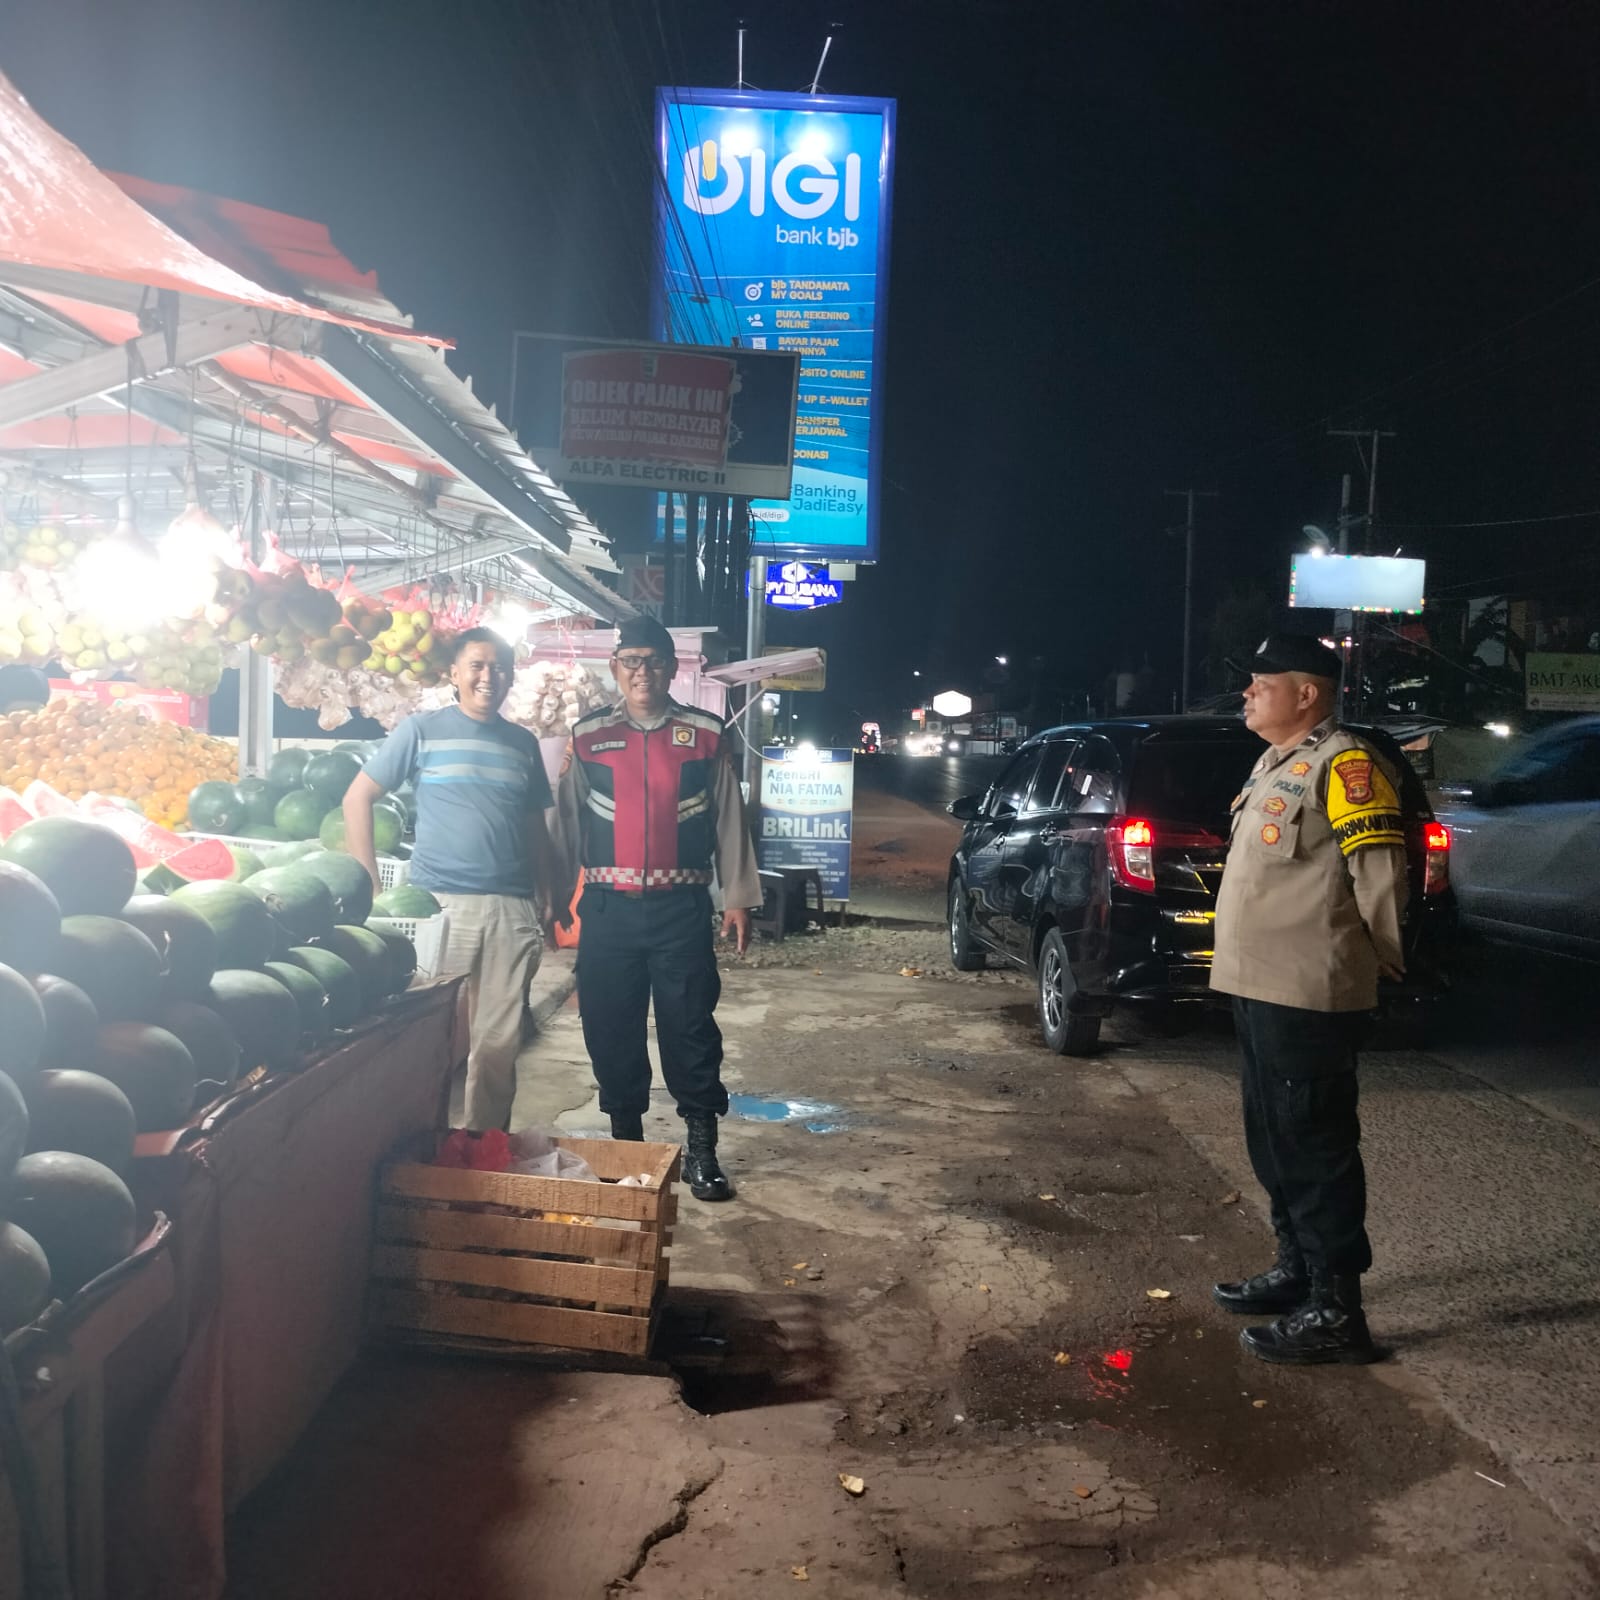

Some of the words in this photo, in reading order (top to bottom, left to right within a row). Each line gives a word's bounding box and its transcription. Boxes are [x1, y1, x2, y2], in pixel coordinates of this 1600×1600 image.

[683, 140, 862, 222] DIGI
[776, 224, 822, 245] bank
[827, 227, 859, 250] bjb
[771, 280, 786, 292] bjb
[789, 280, 850, 291] TANDAMATA
[771, 291, 786, 299] MY
[789, 291, 823, 300] GOALS
[776, 310, 801, 319] BUKA
[803, 311, 850, 321] REKENING
[776, 320, 810, 329] ONLINE
[778, 336, 808, 346] BAYAR
[810, 337, 839, 347] PAJAK
[830, 369, 866, 379] ONLINE
[633, 382, 691, 411] PAJAK
[696, 387, 725, 413] INI
[804, 395, 817, 404] UP
[820, 396, 869, 406] E-WALLET
[630, 410, 721, 435] MEMBAYAR
[569, 461, 615, 477] ALFA
[620, 464, 710, 484] ELECTRIC
[714, 471, 726, 485] II
[793, 499, 864, 516] JadiEasy
[1529, 672, 1568, 687] BMT
[770, 783, 793, 794] NIA
[798, 783, 842, 796] FATMA
[1273, 779, 1305, 797] POLRI
[762, 816, 848, 838] BRILink
